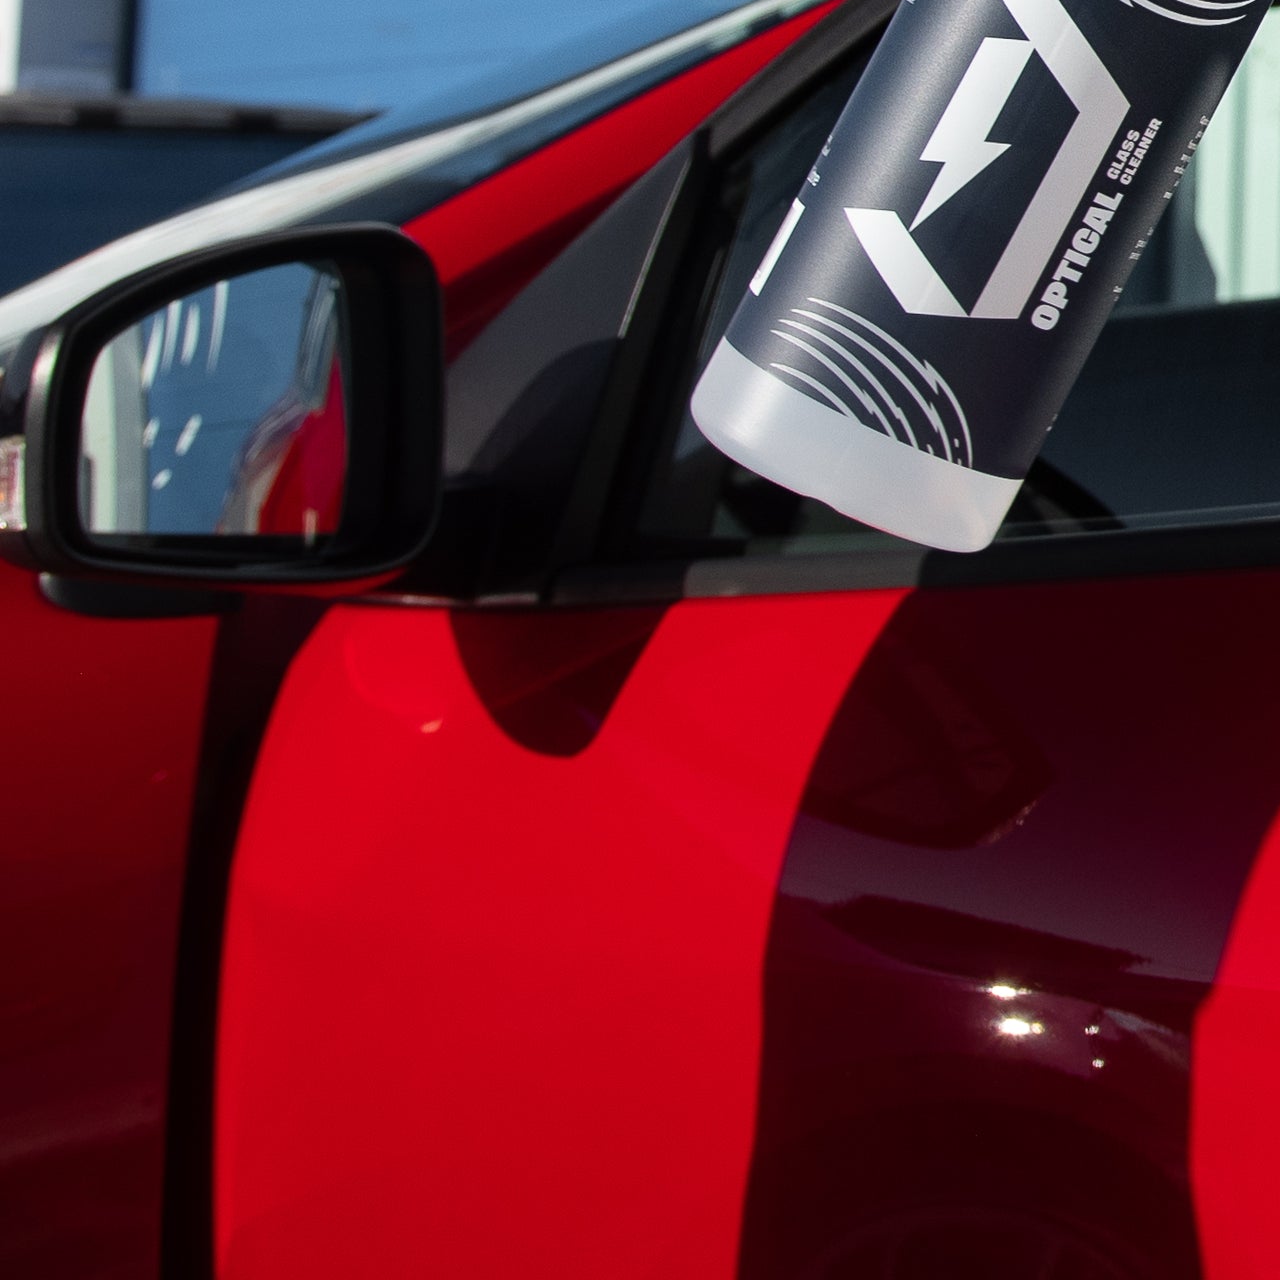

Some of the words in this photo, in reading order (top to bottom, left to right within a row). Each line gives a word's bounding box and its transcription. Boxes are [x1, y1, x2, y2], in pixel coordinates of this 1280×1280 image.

[1106, 129, 1141, 180] GLASS
[1119, 118, 1163, 186] CLEANER
[1031, 192, 1124, 330] OPTICAL
